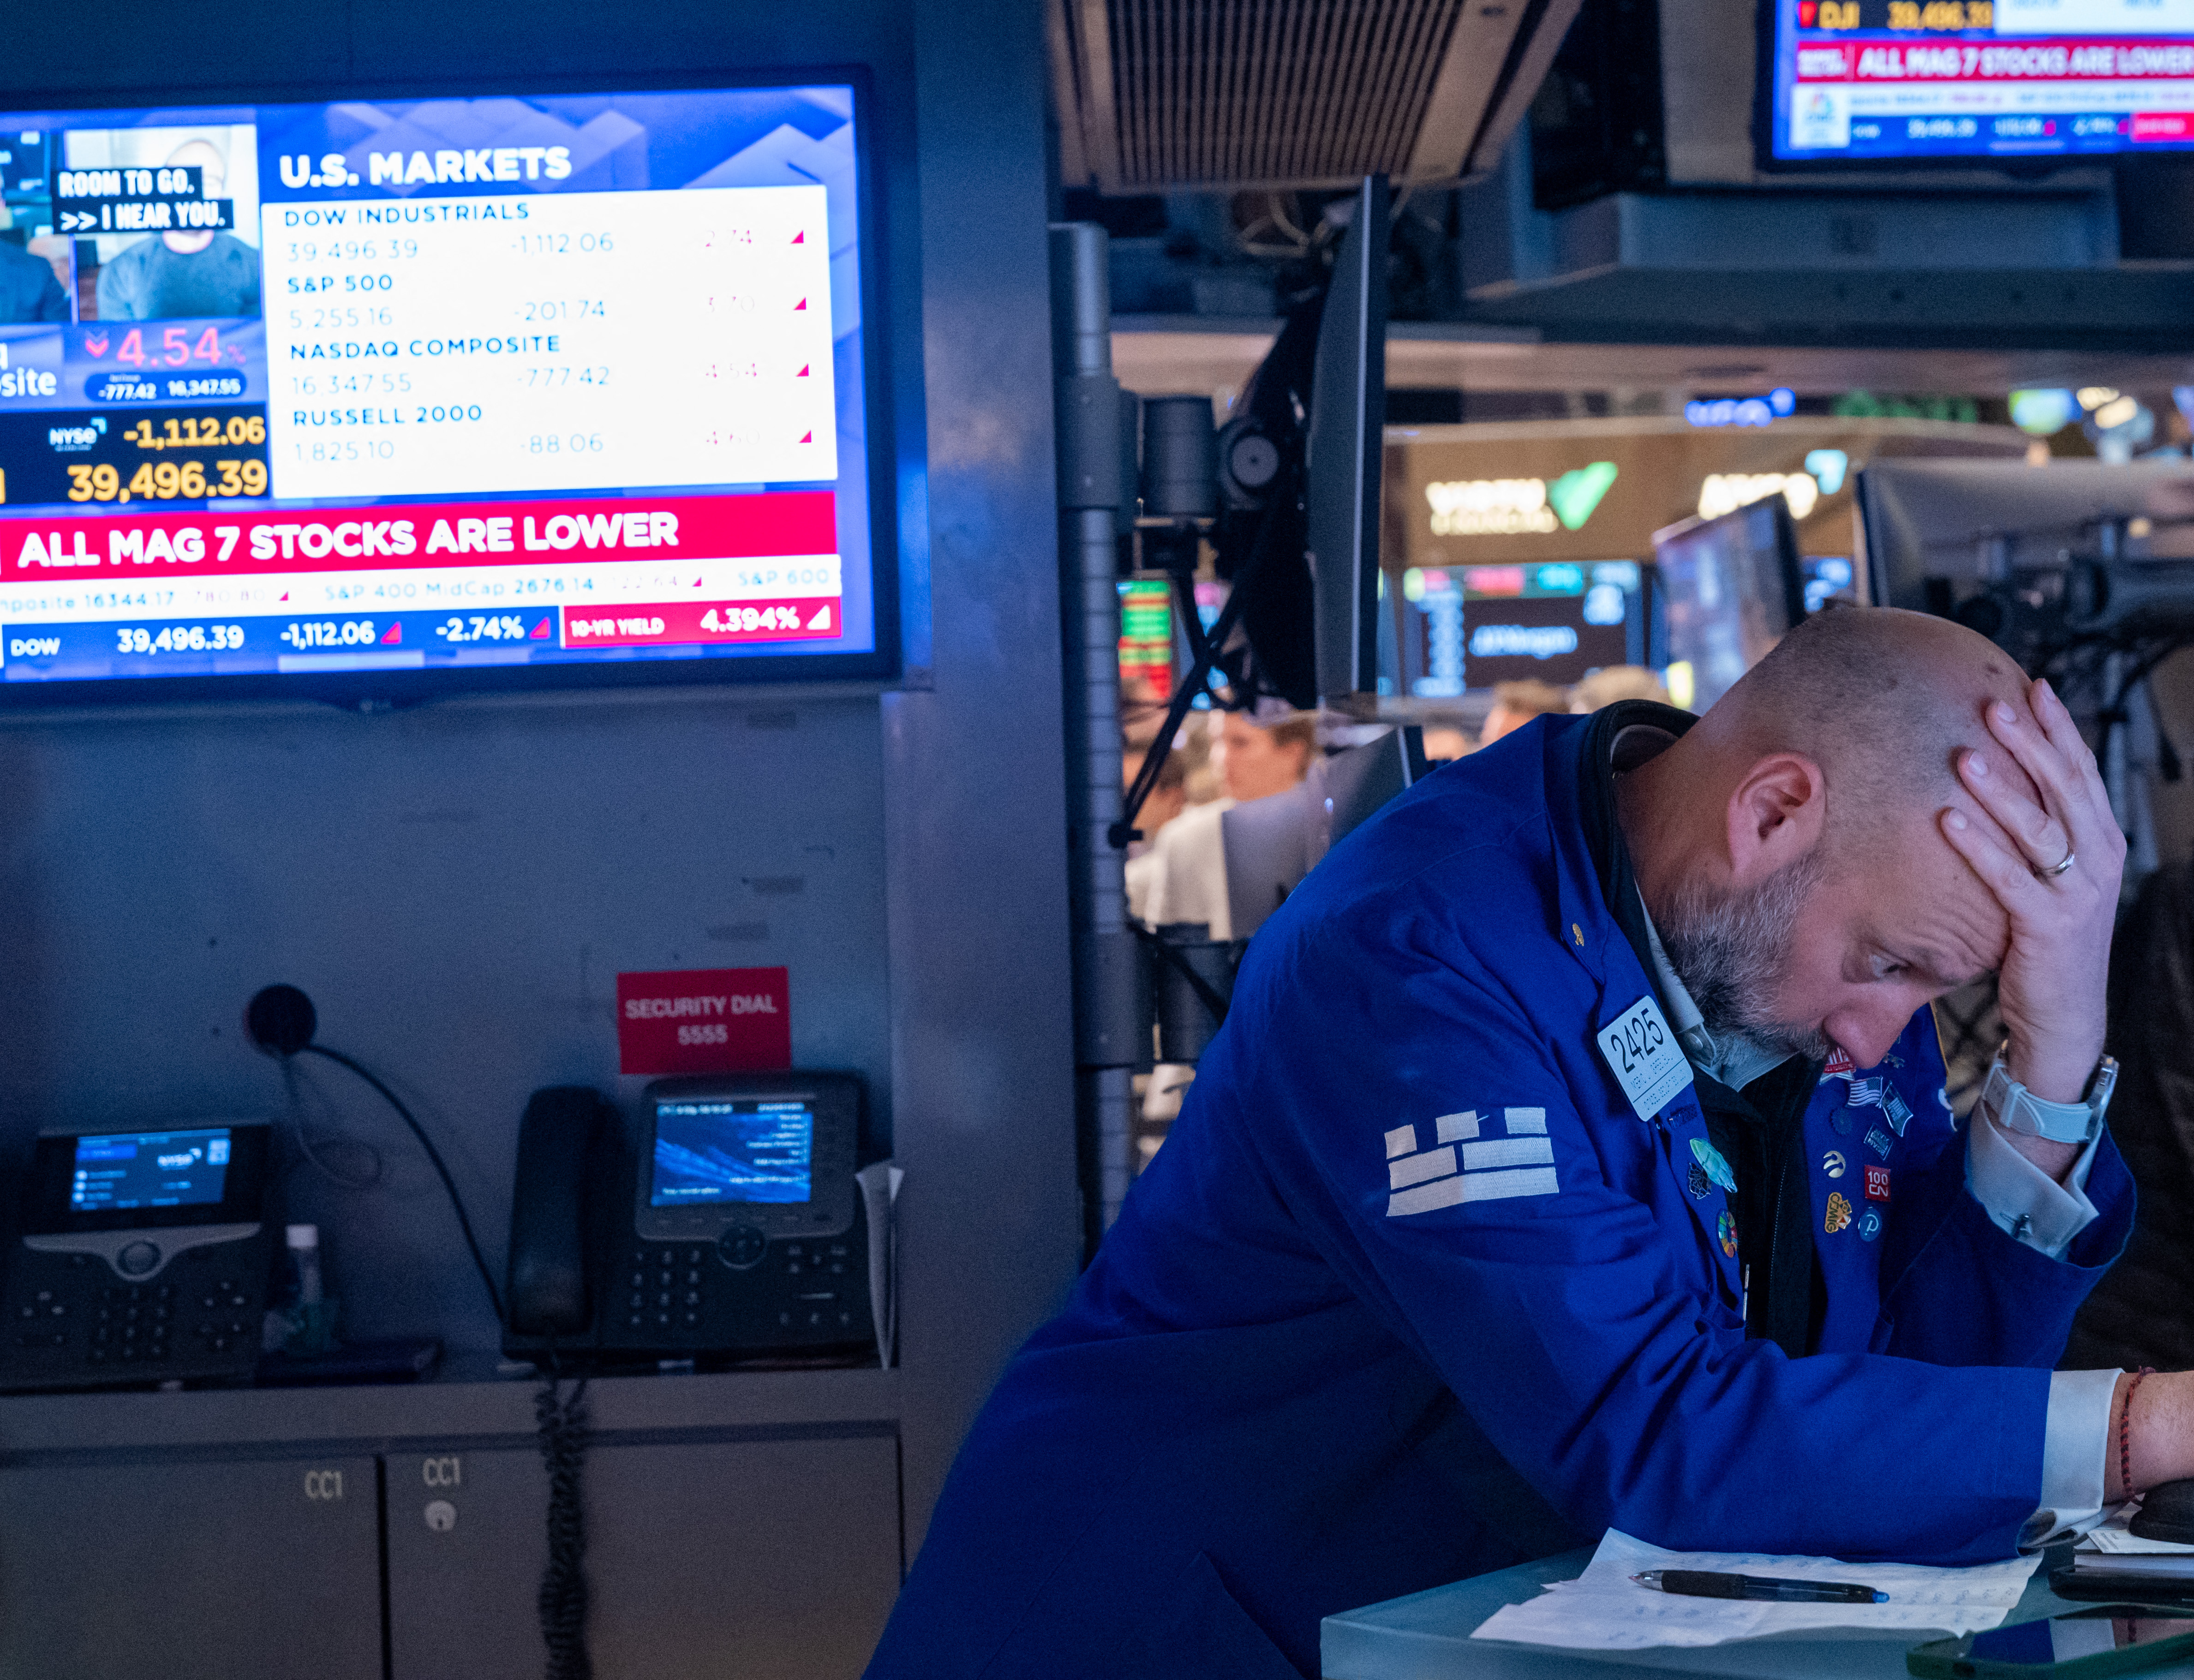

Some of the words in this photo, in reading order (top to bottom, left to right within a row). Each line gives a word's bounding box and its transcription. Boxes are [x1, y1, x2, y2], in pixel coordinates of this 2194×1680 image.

[1857, 47, 1906, 78] ALL
[1905, 46, 1961, 77] MAG
[1962, 47, 1980, 77] 7
[1979, 46, 2070, 77] STOCKS
[2068, 46, 2116, 76] ARE
[280, 154, 359, 188] U.S.
[369, 146, 572, 185] MARKETS
[59, 171, 120, 197] ROOM
[125, 170, 153, 196] TO
[157, 168, 194, 194] GO.
[102, 203, 110, 229] I
[115, 202, 170, 229] HEAR
[175, 202, 225, 227] YOU.
[285, 209, 346, 227] DOW
[359, 203, 528, 223] INDUSTRIALS
[288, 276, 334, 293] S&P
[345, 274, 392, 291] 500
[291, 341, 398, 359] NASDAQ
[410, 335, 560, 356] COMPOSITE
[0, 368, 57, 397] site
[294, 408, 405, 426] RUSSELL
[417, 405, 481, 423] 2000
[124, 416, 266, 450] -1,112.06
[67, 459, 268, 503] 39,496.39
[18, 531, 101, 568] ALL
[109, 527, 205, 565] MAG
[215, 526, 240, 561] 7
[250, 520, 417, 560] STOCKS
[425, 517, 514, 554] ARE
[523, 511, 679, 551] LOWER
[324, 584, 365, 601] S&P
[374, 582, 417, 598] 400
[426, 580, 505, 597] MidCap
[738, 570, 777, 586] S&P
[787, 568, 829, 585] 600
[10, 638, 60, 657] DOW
[117, 624, 245, 656] 39,496.39
[280, 620, 376, 650] -1,112.06
[436, 615, 525, 642] -2.74%
[570, 619, 615, 637] 10-YR
[617, 617, 665, 636] YIELD
[700, 606, 801, 632] 4.394%
[625, 995, 727, 1019] SECURITY
[730, 993, 778, 1015] DIAL
[678, 1024, 728, 1046] 5555
[1610, 1008, 1664, 1074] 2425
[1868, 1171, 1888, 1185] 100
